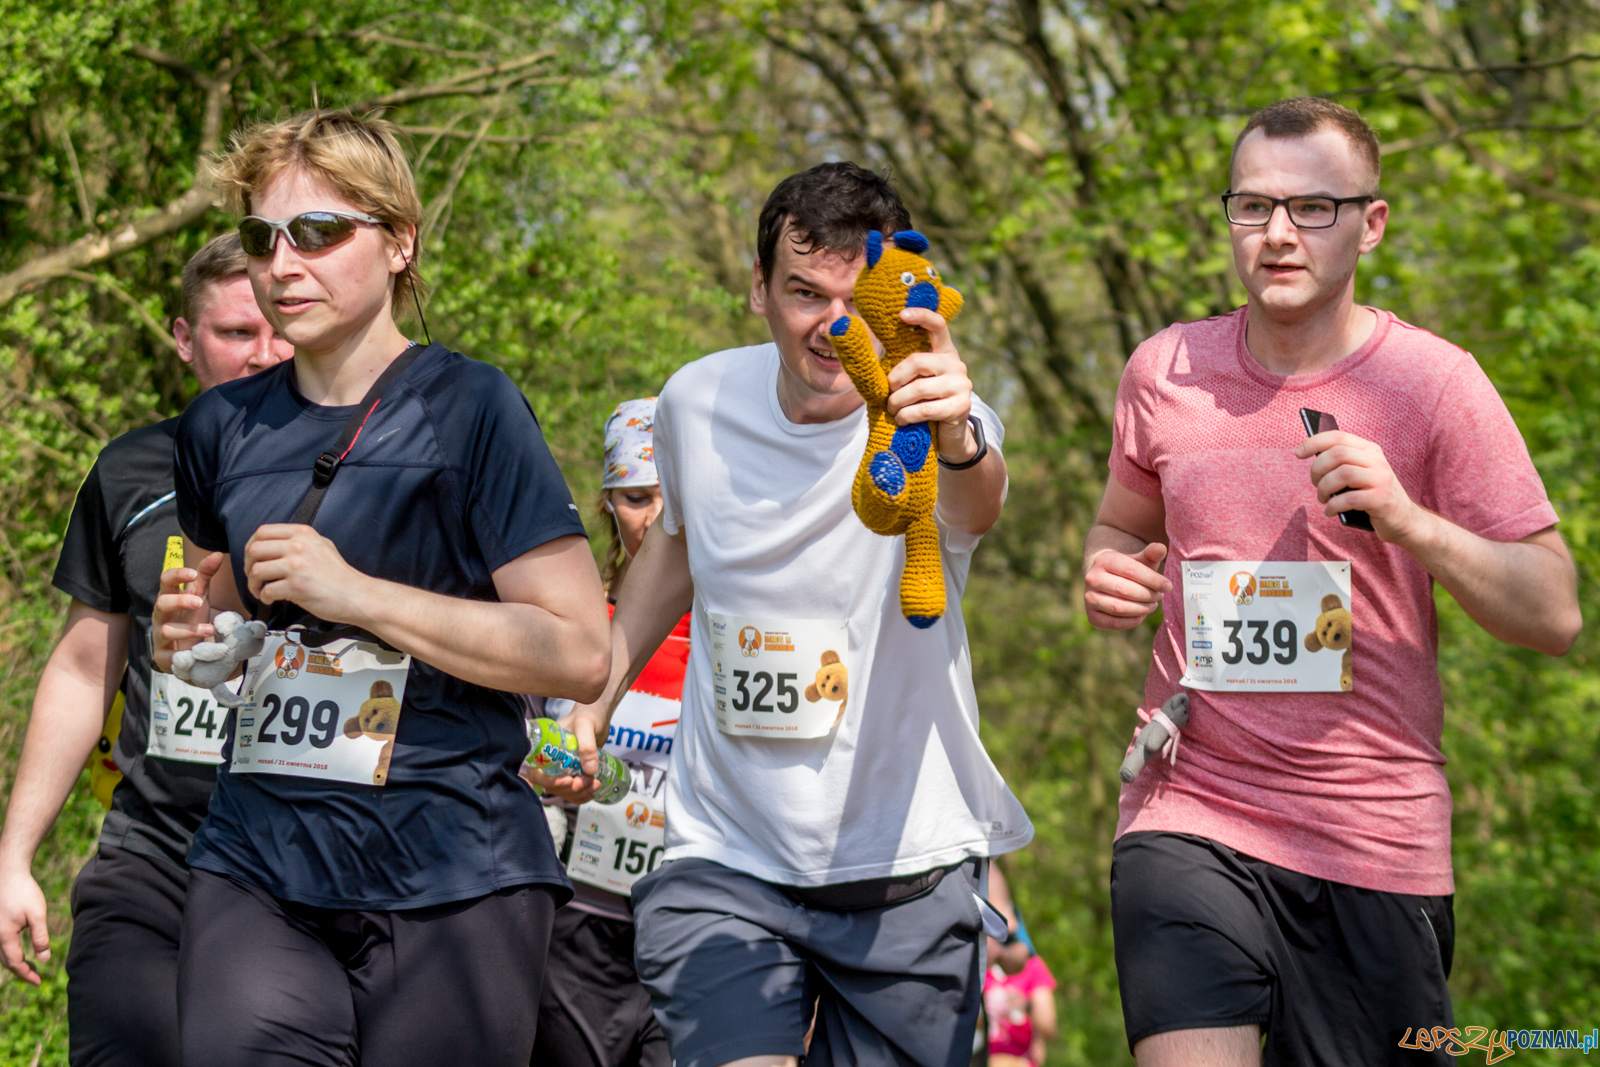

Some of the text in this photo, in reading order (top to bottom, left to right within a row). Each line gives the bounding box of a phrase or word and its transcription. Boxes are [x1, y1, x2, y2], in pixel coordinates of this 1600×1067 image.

[1221, 619, 1298, 666] 339
[732, 669, 799, 714] 325
[175, 697, 231, 740] 247
[257, 693, 340, 749] 299
